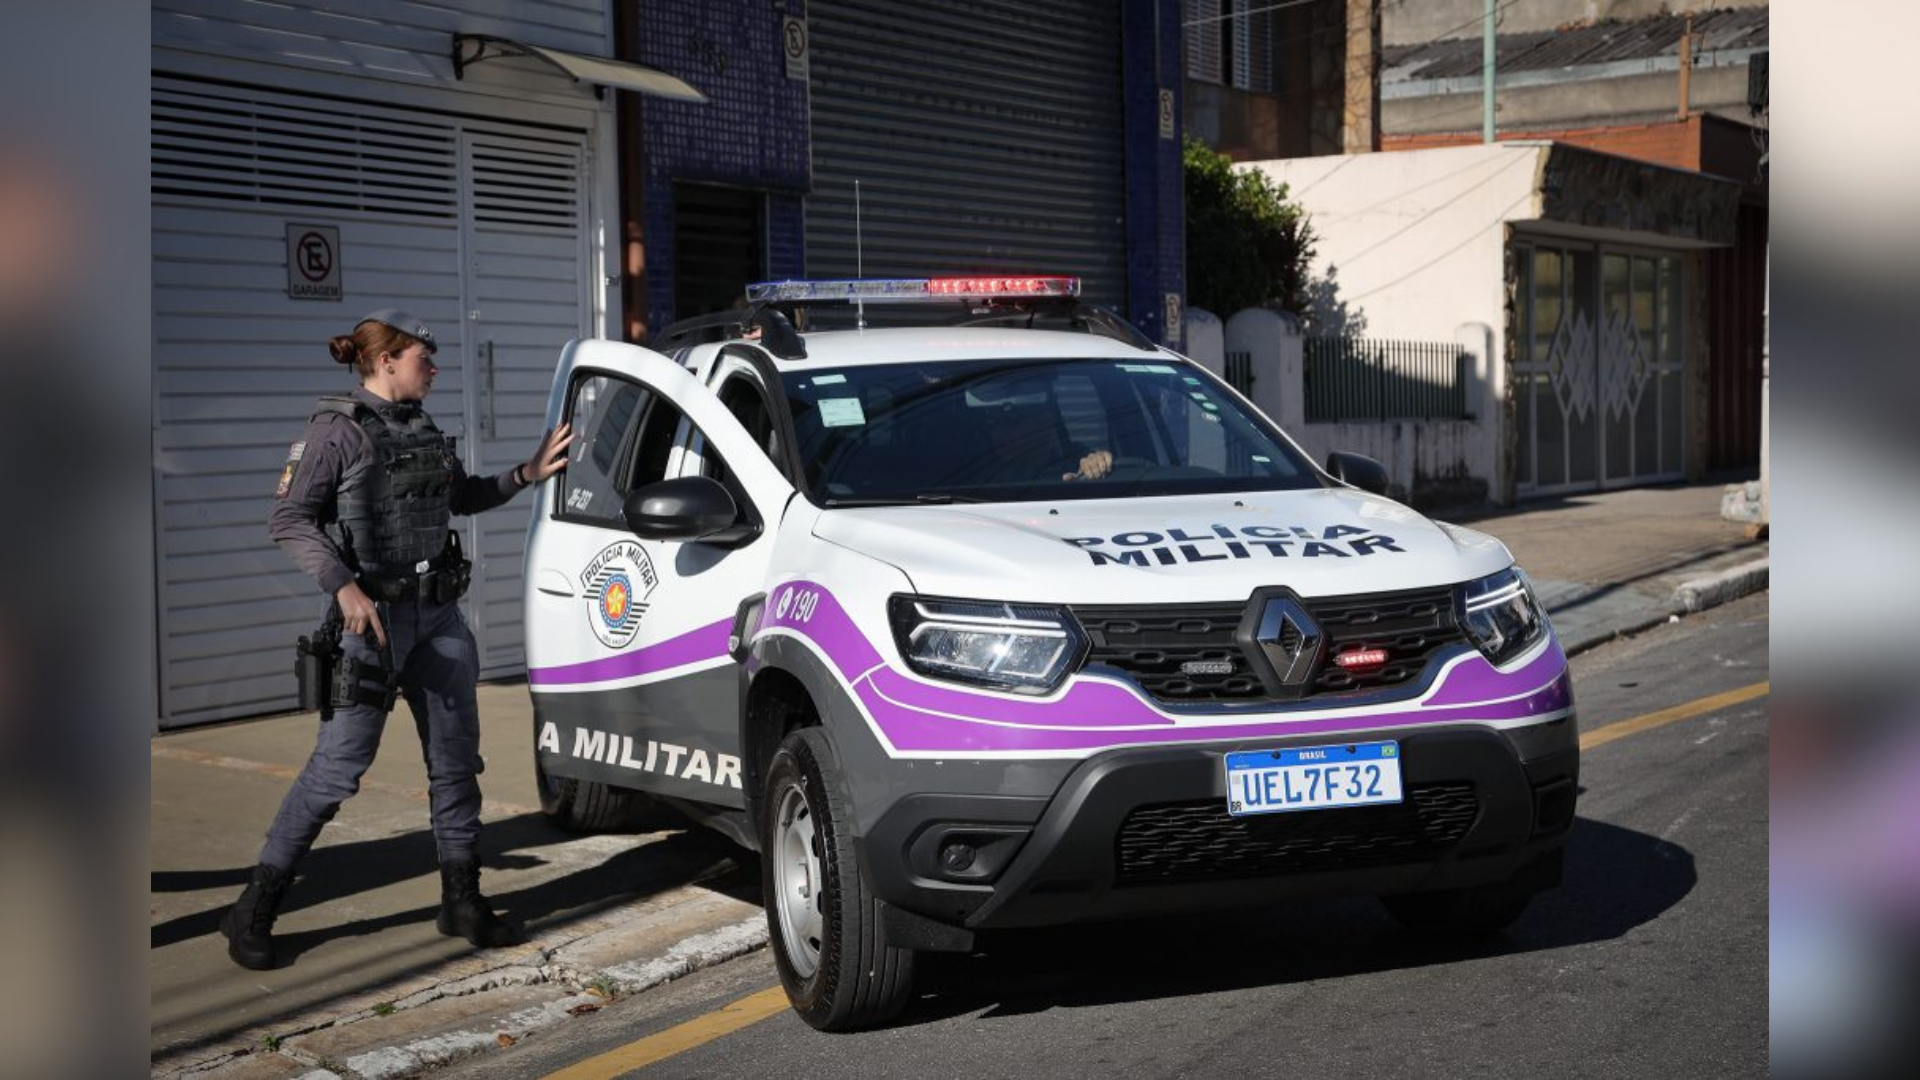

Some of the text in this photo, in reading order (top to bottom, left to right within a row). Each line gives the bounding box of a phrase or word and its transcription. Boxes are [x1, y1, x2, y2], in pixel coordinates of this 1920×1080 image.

[293, 284, 338, 296] GARAGEM
[626, 545, 654, 589] MILITAR
[1088, 535, 1406, 566] MILITAR
[789, 589, 819, 623] 190
[538, 721, 743, 789] A MILITAR
[1299, 750, 1327, 760] BRASIL
[1242, 765, 1383, 806] UEL7F32
